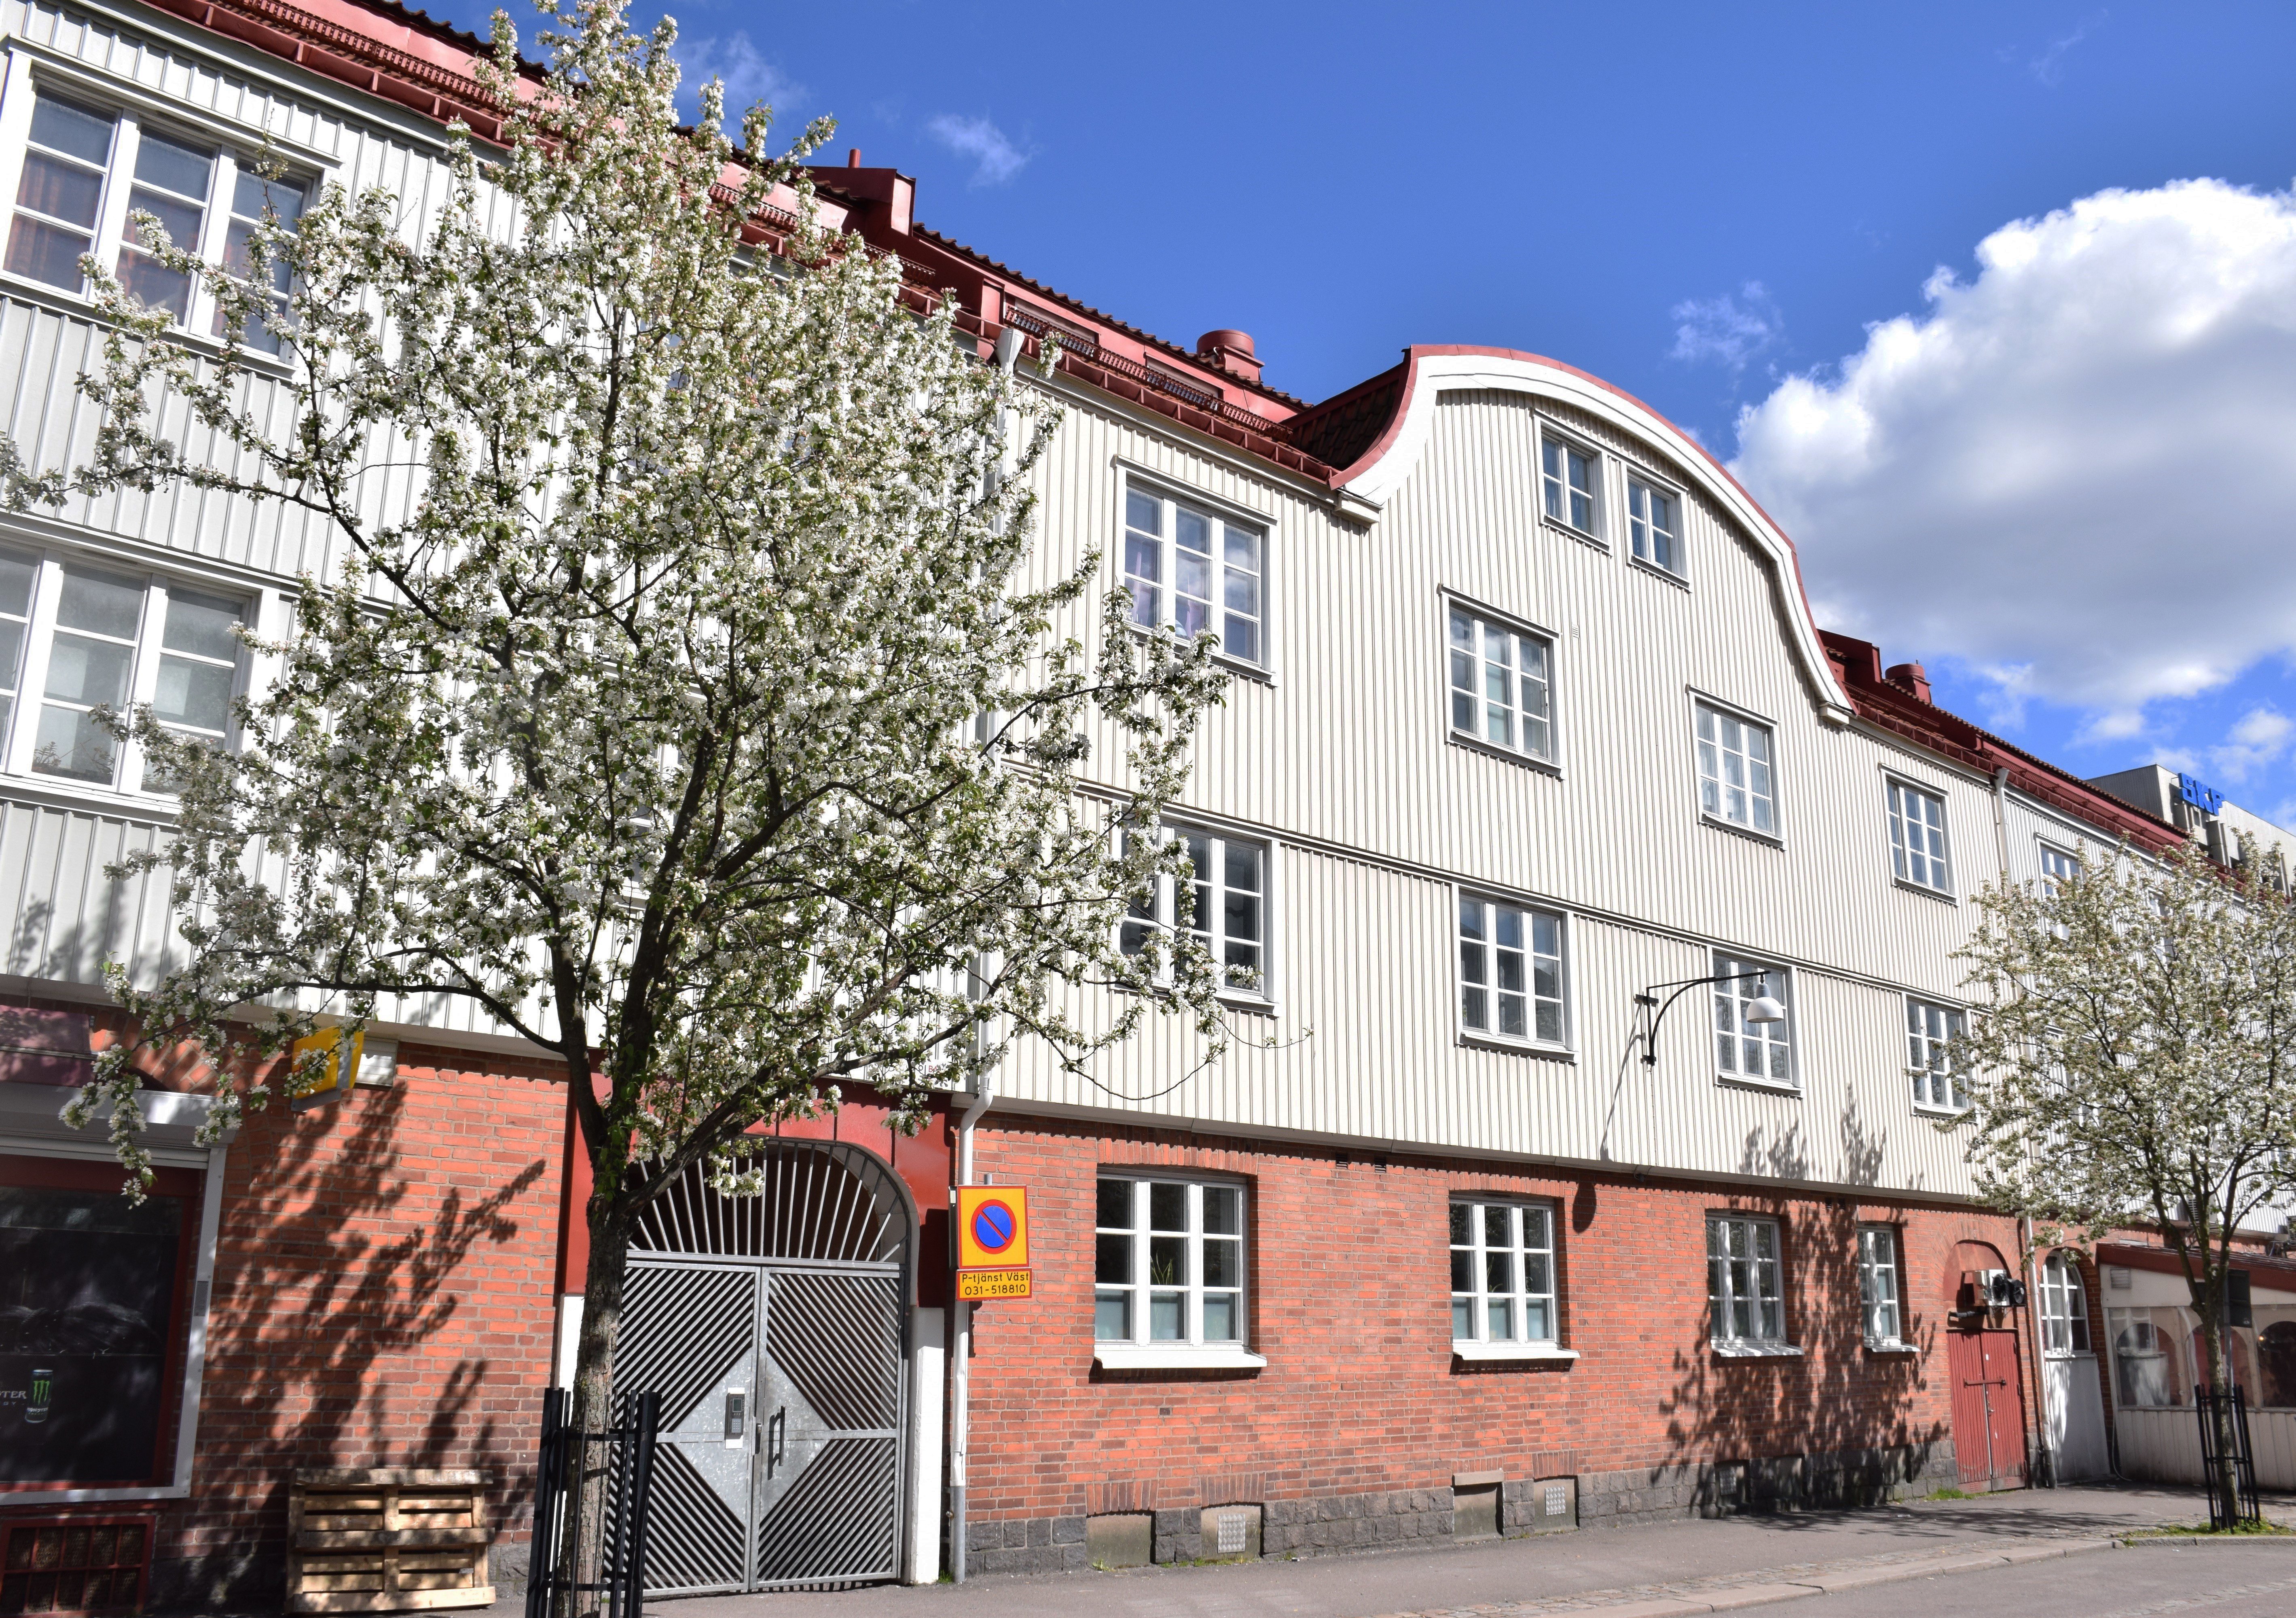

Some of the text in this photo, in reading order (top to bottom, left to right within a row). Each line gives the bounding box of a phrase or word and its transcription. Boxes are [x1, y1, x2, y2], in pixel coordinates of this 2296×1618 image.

[2177, 773, 2225, 816] SKF
[962, 1272, 1028, 1284] P-tjänst Väst
[965, 1284, 1026, 1295] 031-518810
